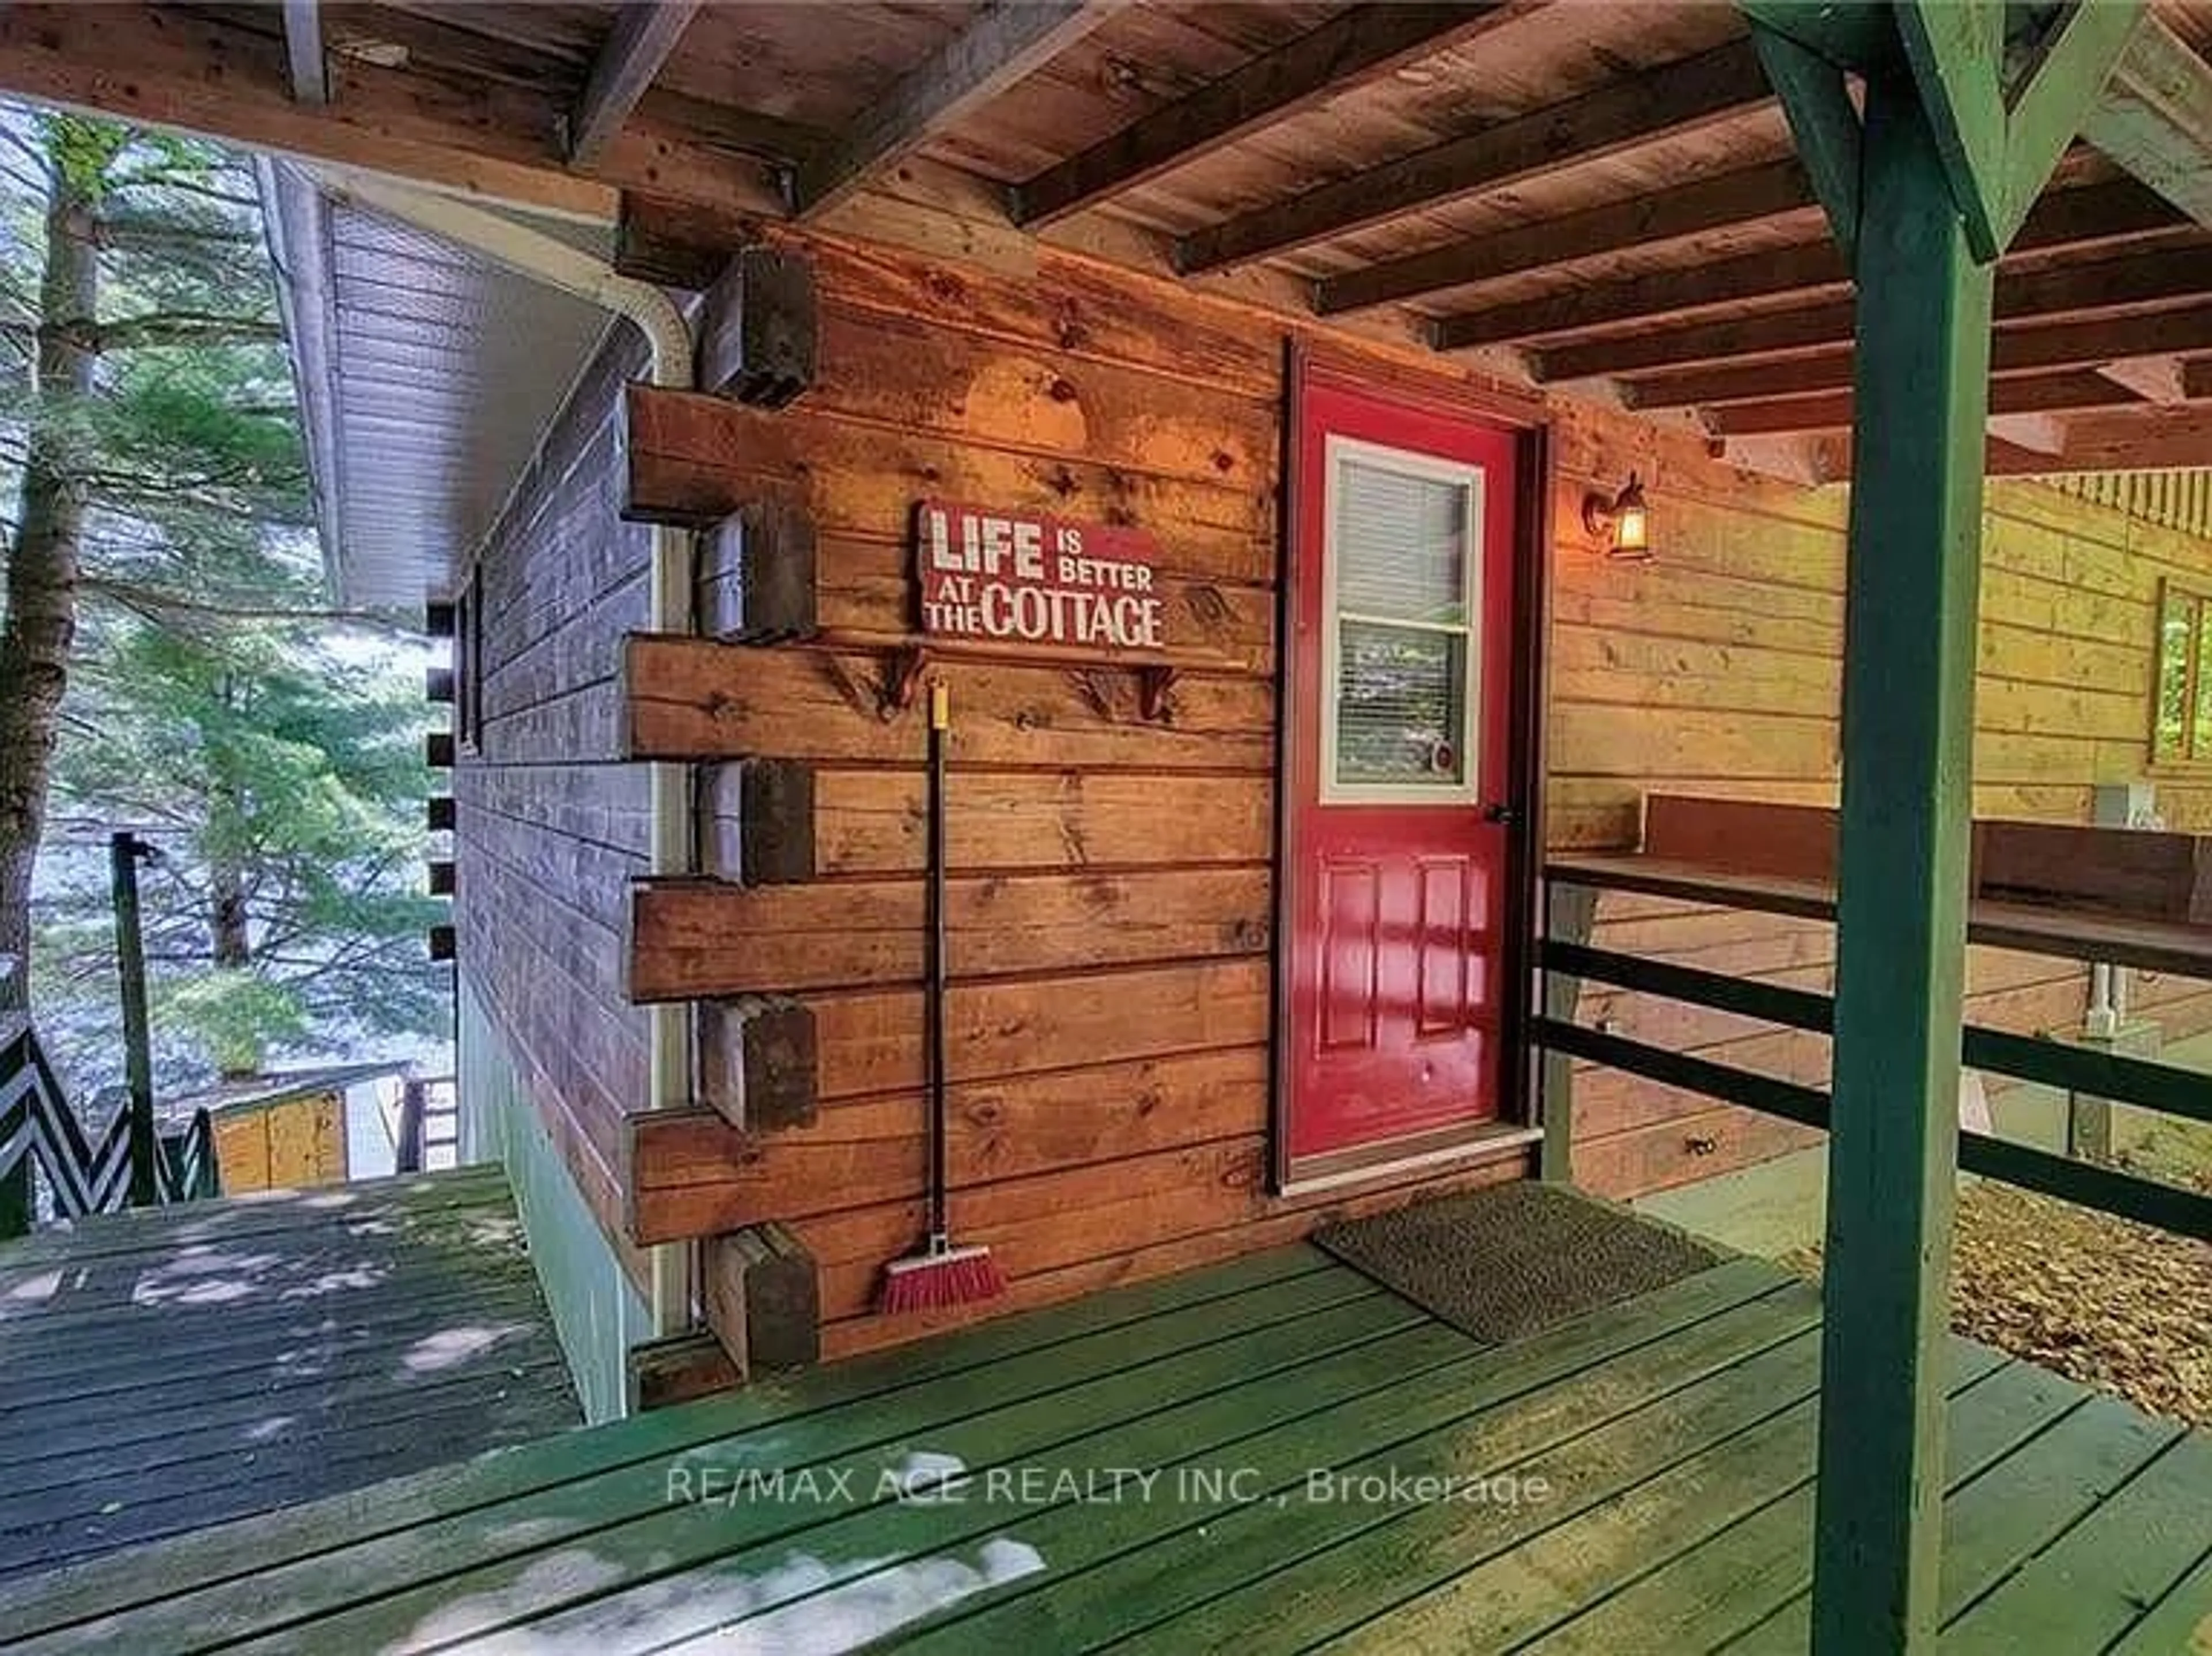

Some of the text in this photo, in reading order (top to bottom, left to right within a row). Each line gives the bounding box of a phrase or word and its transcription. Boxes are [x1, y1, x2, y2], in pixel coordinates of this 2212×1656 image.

[930, 510, 1081, 579] LIFE IS
[939, 575, 974, 603] AT
[1059, 558, 1151, 591] BETTER
[925, 582, 1164, 647] THE COTTAGE
